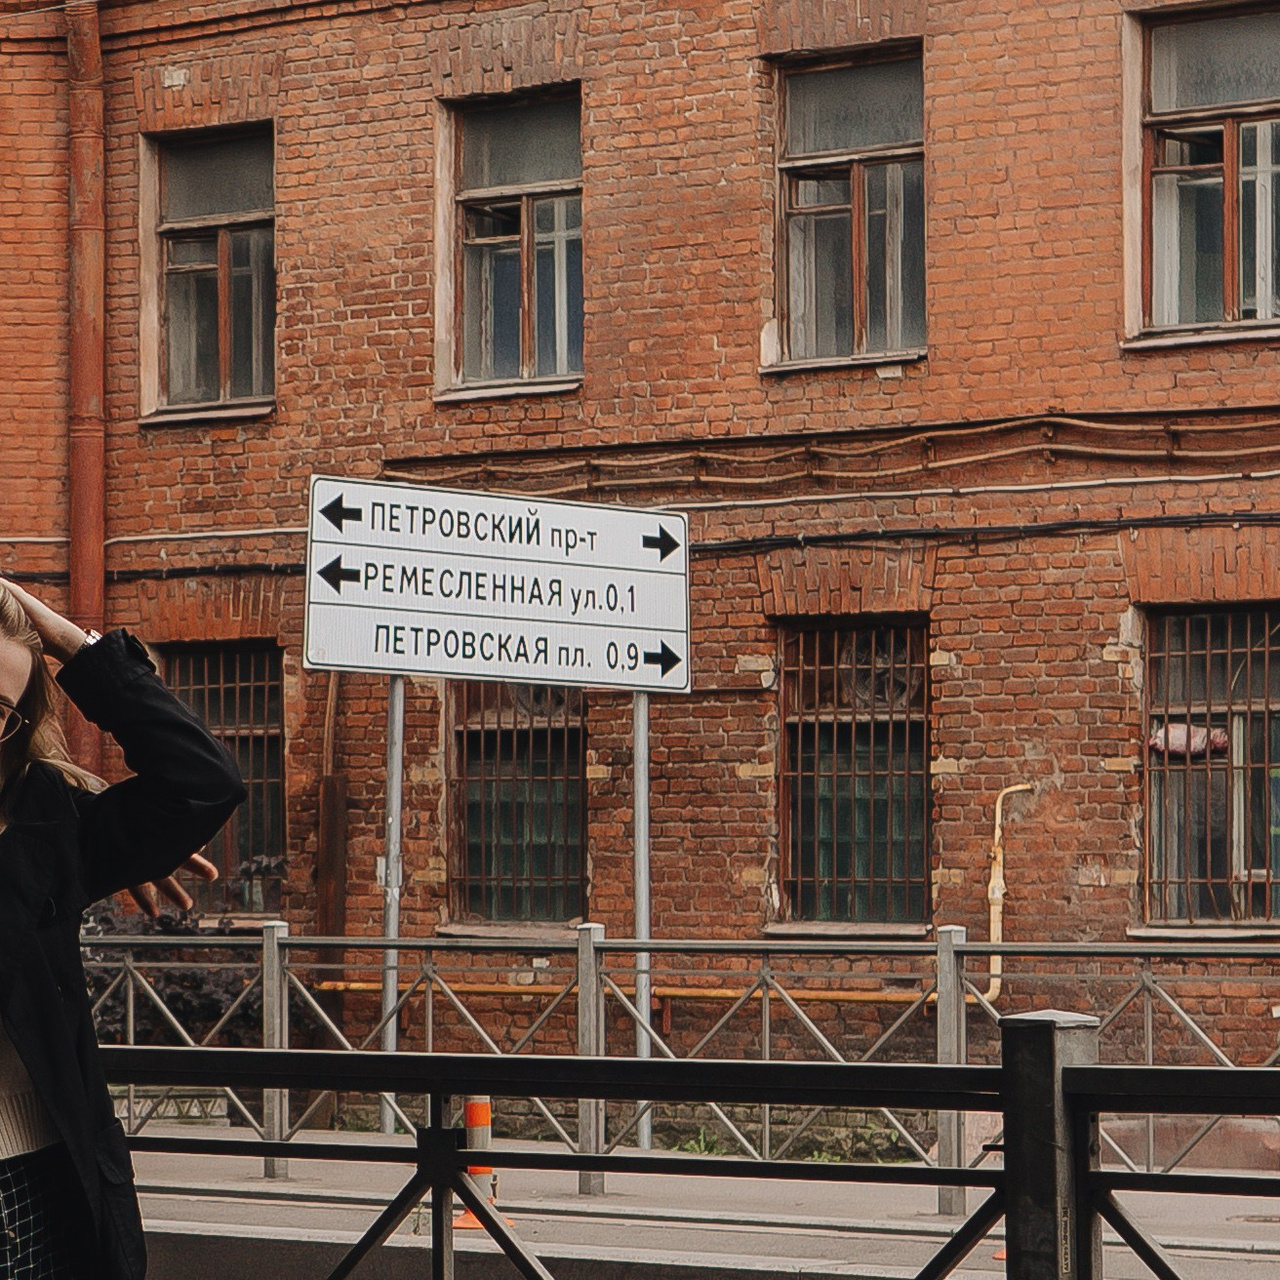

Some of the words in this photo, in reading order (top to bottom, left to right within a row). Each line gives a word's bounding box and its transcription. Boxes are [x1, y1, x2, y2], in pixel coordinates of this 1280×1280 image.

[370, 501, 541, 546] ПЕТРОВСКИЙ
[550, 528, 598, 558] пр-т
[364, 562, 563, 608] РЕМЕСЛЕННАЯ
[373, 624, 549, 666] ПЕТРОВСКАЯ
[557, 646, 592, 669] пл.
[606, 641, 639, 672] 0,9
